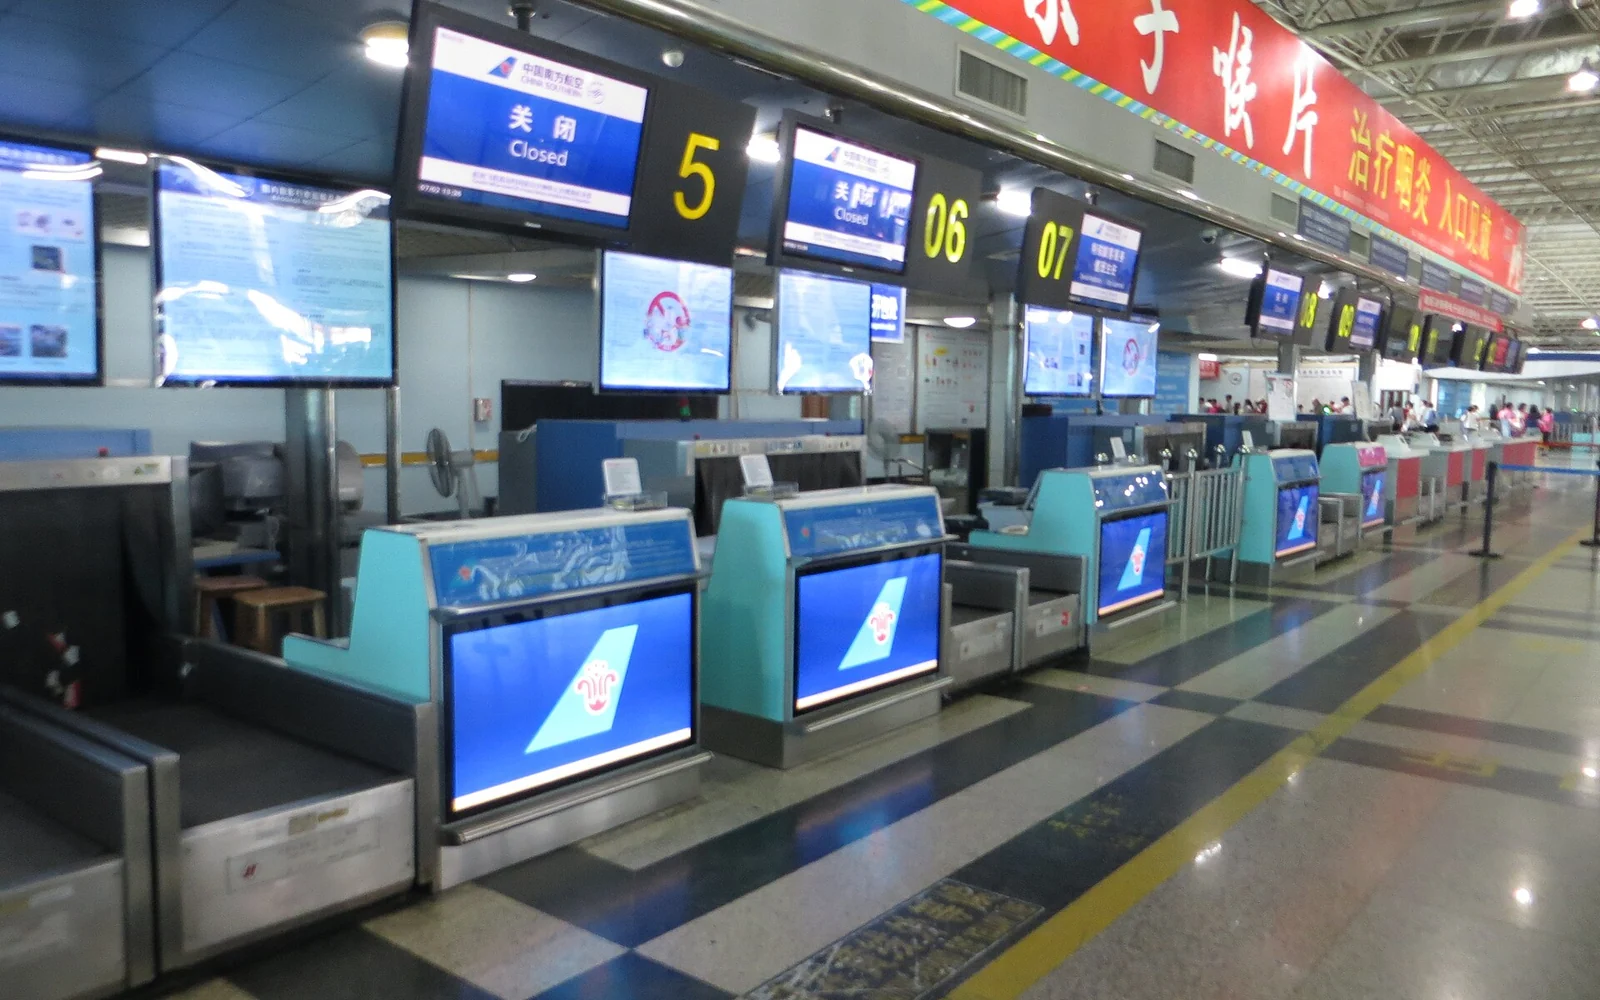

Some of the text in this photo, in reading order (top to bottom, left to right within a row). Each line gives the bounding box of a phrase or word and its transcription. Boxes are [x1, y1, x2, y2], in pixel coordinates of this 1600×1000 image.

[522, 63, 584, 88] 中国南方航空
[510, 139, 569, 167] Closed
[673, 132, 720, 220] 5
[834, 206, 869, 226] Closed
[923, 193, 969, 263] 06
[1037, 221, 1074, 281] 07
